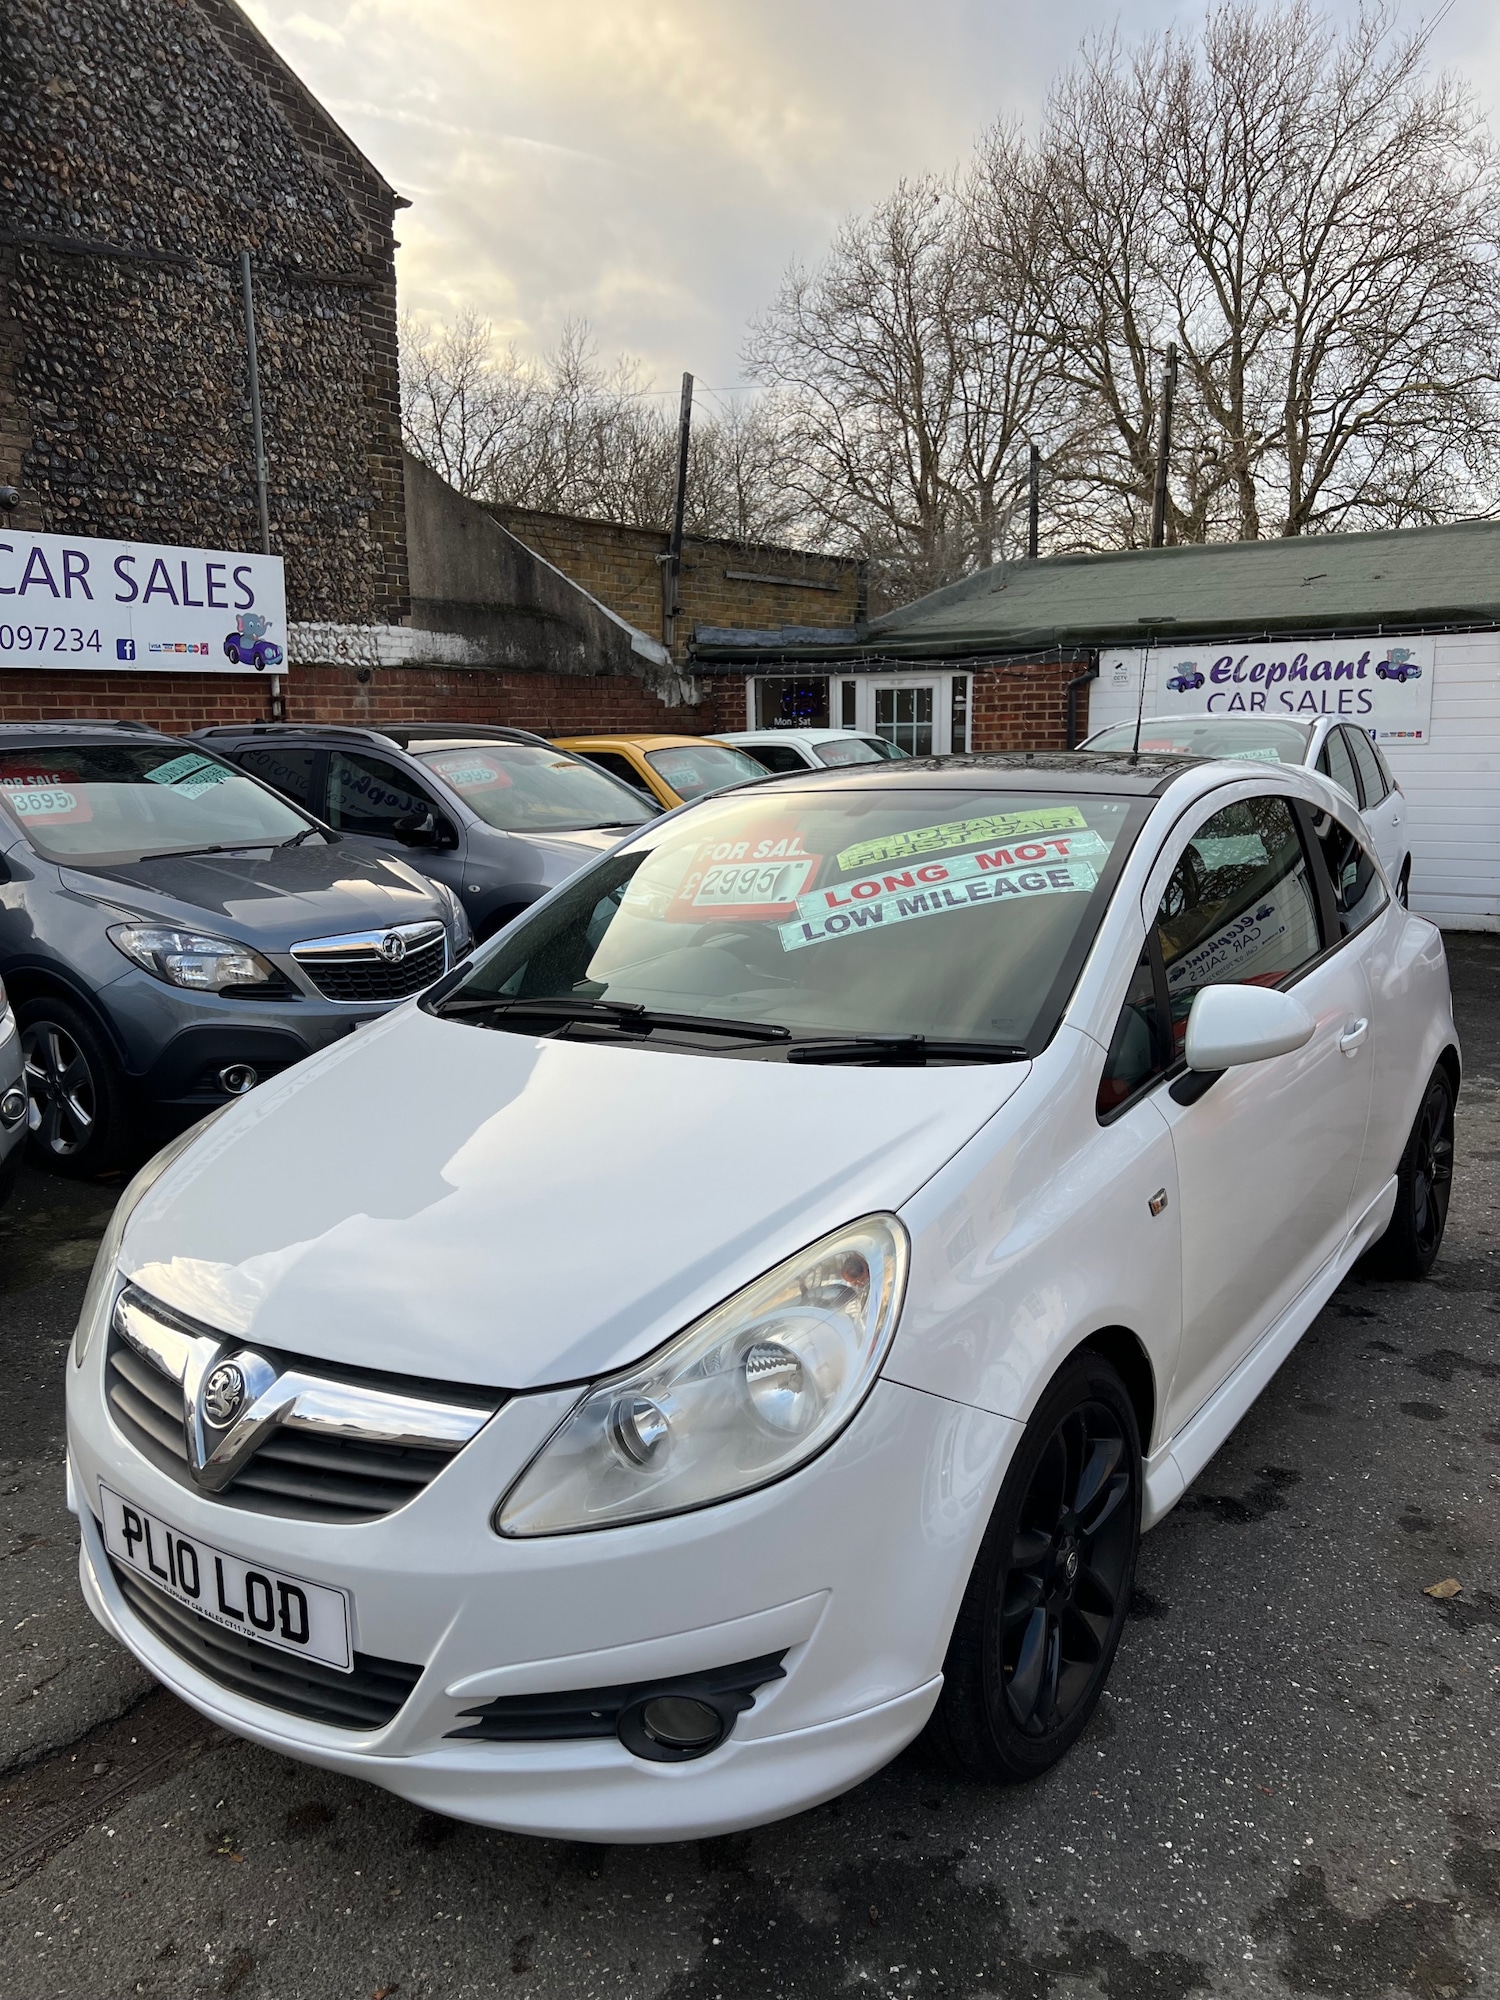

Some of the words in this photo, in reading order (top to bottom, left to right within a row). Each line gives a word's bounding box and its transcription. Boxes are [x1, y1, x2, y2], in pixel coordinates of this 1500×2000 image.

[114, 555, 255, 610] SALES
[0, 624, 103, 653] 097234
[1210, 650, 1371, 690] Elephant
[1207, 691, 1267, 712] CAR
[1279, 689, 1373, 714] SALES
[774, 717, 792, 726] Mon
[798, 717, 811, 726] Sat
[0, 776, 26, 790] OR
[26, 773, 61, 788] SALE
[452, 768, 493, 785] 2995
[12, 791, 69, 812] 3695
[849, 830, 973, 867] FIRST
[981, 816, 1074, 838] CAR
[893, 815, 1021, 846] IDEAL
[697, 841, 750, 862] FOR
[824, 864, 949, 908] LONG
[974, 838, 1072, 871] MOT
[802, 903, 883, 941] LOW
[895, 868, 1075, 917] MILEAGE
[122, 1504, 200, 1599] PL10
[214, 1556, 310, 1645] LOD
[163, 1584, 190, 1606] ELEPHANT
[191, 1602, 203, 1614] CAR
[204, 1609, 224, 1624] SALES
[224, 1619, 241, 1632] CT11
